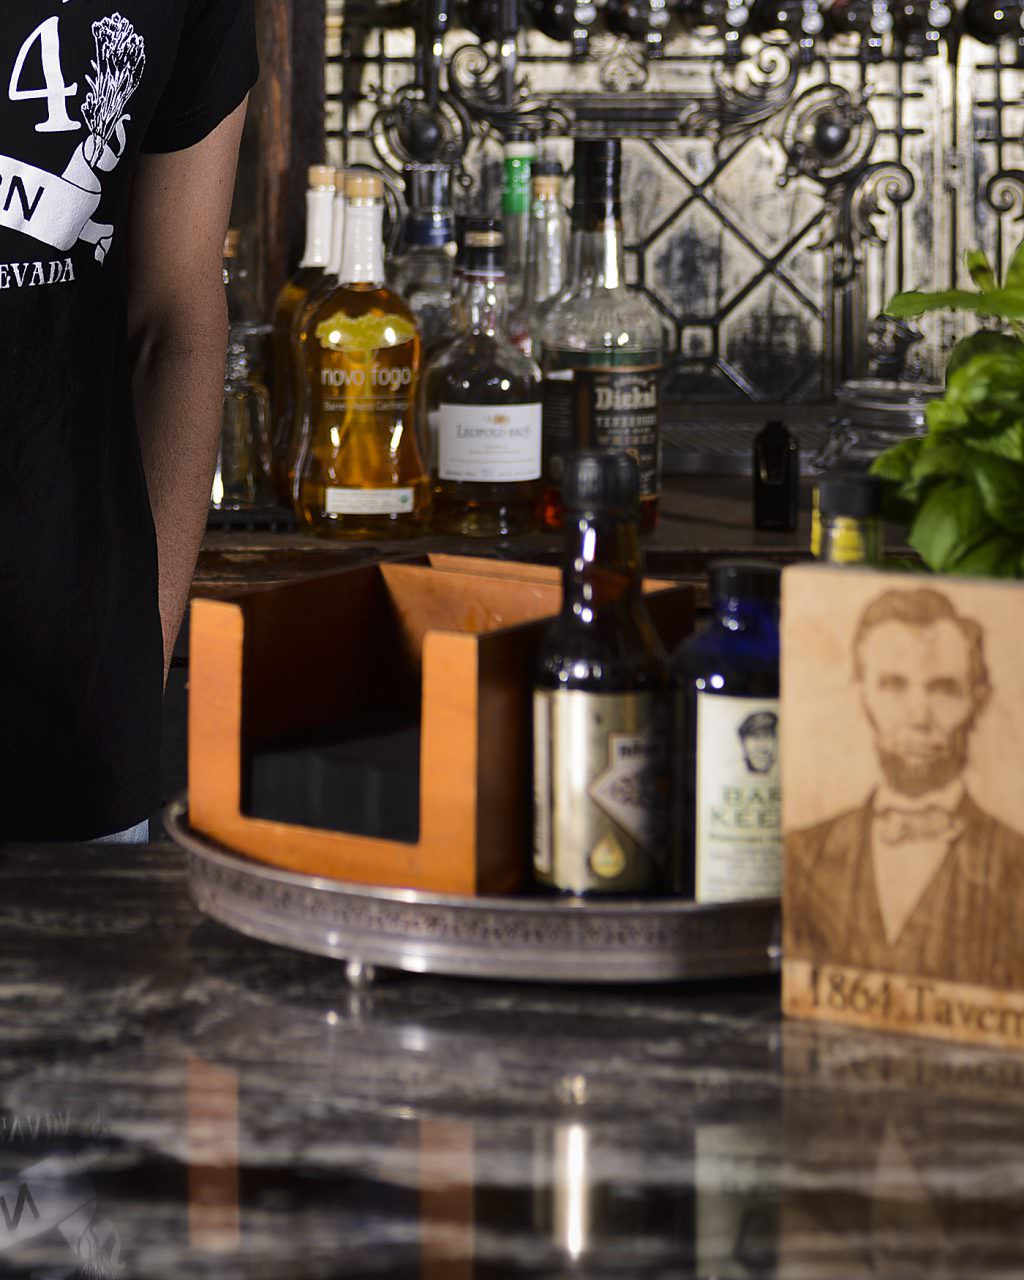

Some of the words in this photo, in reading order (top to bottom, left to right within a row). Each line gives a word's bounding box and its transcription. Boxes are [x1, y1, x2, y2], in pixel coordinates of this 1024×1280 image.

[320, 367, 365, 387] novo
[369, 361, 412, 392] fogo
[809, 969, 895, 1019] 1864
